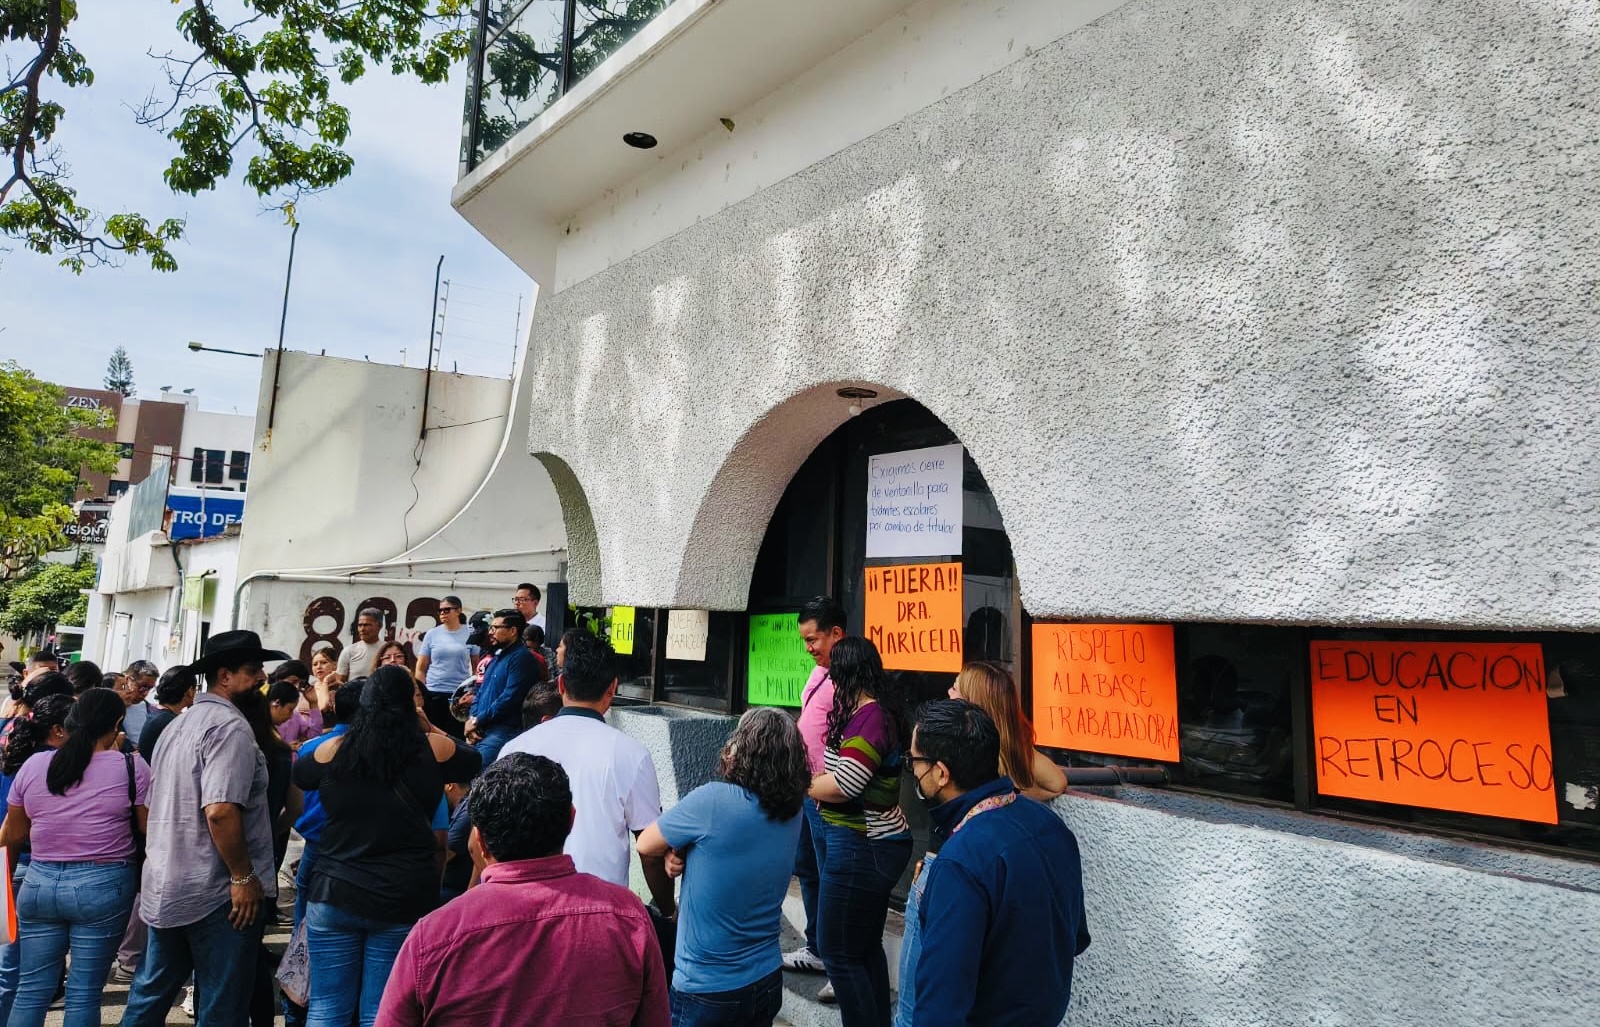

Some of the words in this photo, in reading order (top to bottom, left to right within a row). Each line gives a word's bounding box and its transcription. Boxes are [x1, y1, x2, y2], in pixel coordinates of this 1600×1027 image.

[67, 396, 100, 410] ZEN
[871, 485, 881, 498] de
[927, 482, 949, 500] para
[902, 501, 938, 517] escolares
[869, 522, 881, 536] por
[884, 520, 912, 534] cambio
[913, 520, 924, 533] de
[927, 516, 957, 534] titular
[897, 601, 932, 623] DRA.
[1052, 629, 1145, 664] RESPETO
[1318, 645, 1543, 693] EDUCACIÓN
[1093, 673, 1153, 708] BASE
[1373, 694, 1419, 725] EN
[1040, 706, 1178, 750] TRABAJADORA
[1319, 736, 1554, 791] RETROCESO
